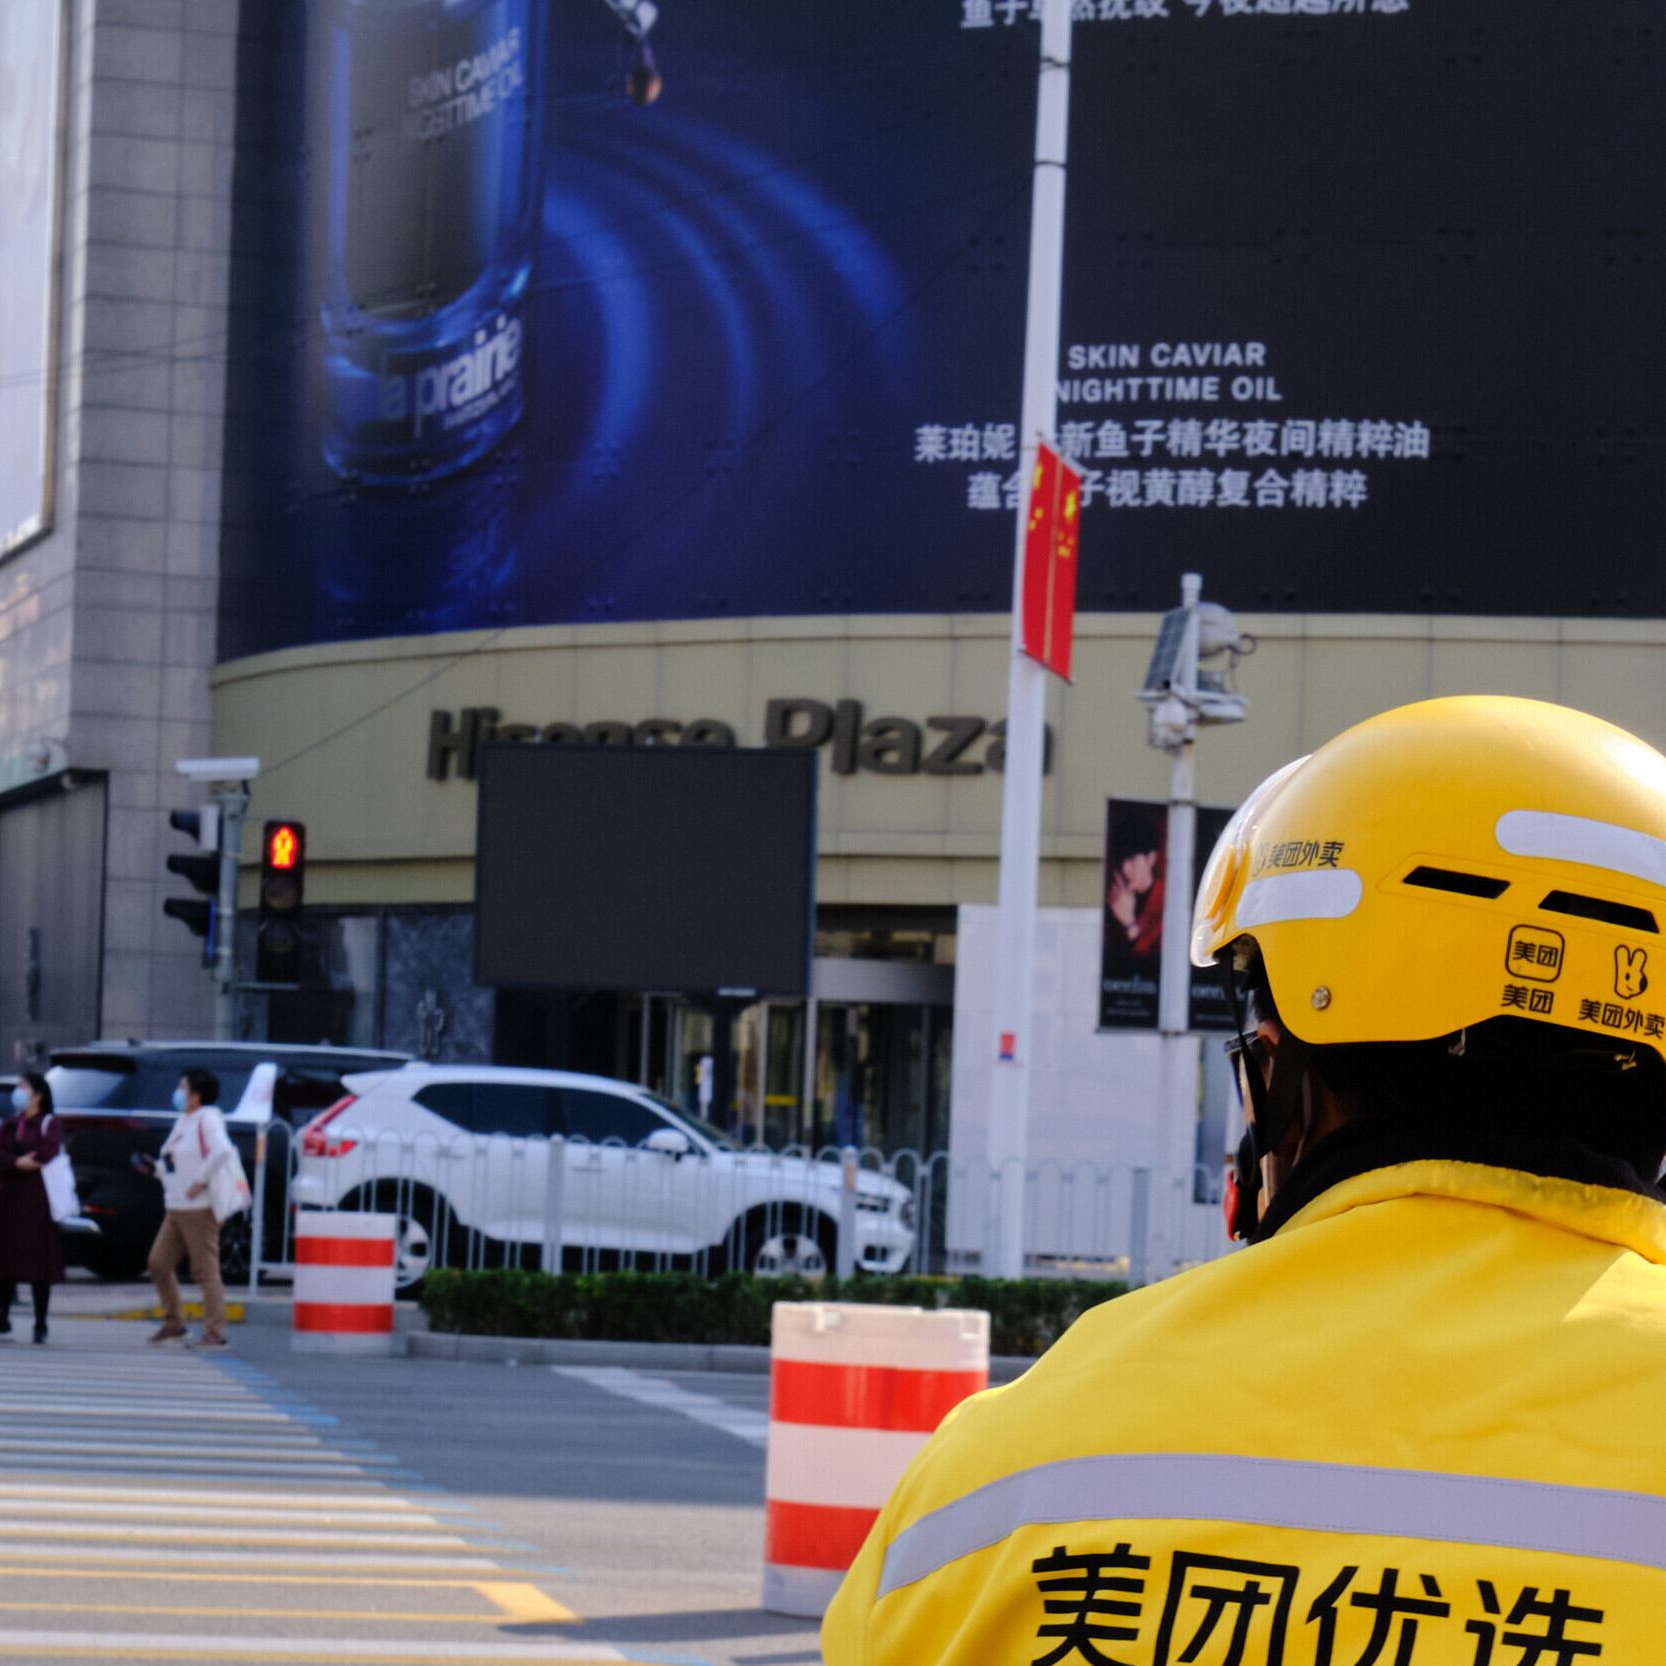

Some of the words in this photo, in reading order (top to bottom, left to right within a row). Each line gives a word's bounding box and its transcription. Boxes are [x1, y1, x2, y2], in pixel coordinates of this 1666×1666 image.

[1068, 345, 1139, 369] SKIN
[1150, 342, 1266, 367] CAVIAR
[1231, 376, 1282, 400] OIL
[914, 419, 1430, 462] 莱珀妮新鱼子精华夜间精粹油
[1266, 840, 1345, 869] 美团外卖
[1513, 939, 1559, 968] 美团
[1501, 984, 1554, 1014] 美团
[1578, 999, 1666, 1040] 美团外卖
